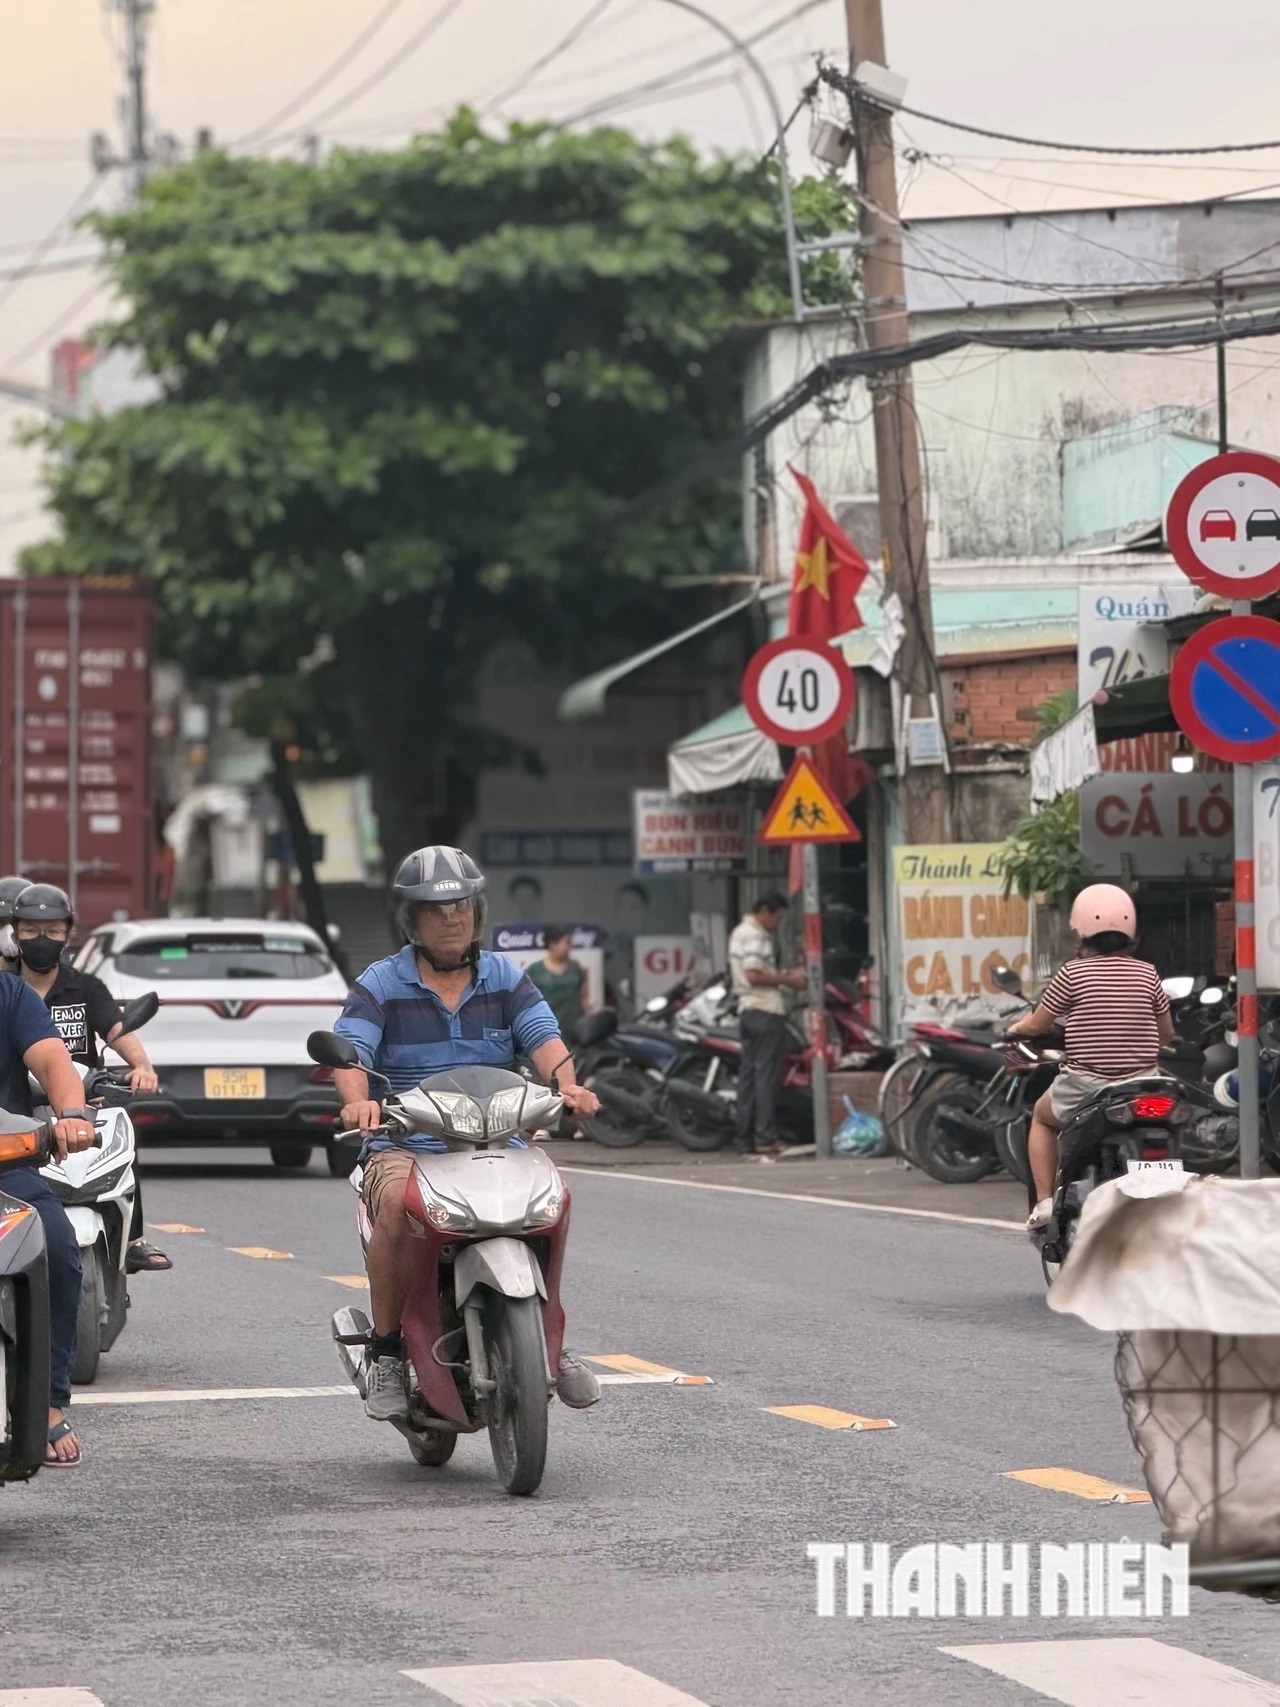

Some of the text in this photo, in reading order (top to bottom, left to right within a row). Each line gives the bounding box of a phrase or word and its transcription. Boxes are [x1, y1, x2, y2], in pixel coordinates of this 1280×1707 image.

[1095, 595, 1170, 621] Quán
[776, 668, 819, 714] 40
[1094, 782, 1164, 839] CÁ
[903, 887, 1030, 940] BÁNH CANH
[906, 949, 955, 997] CÁ
[222, 1070, 248, 1084] 95H
